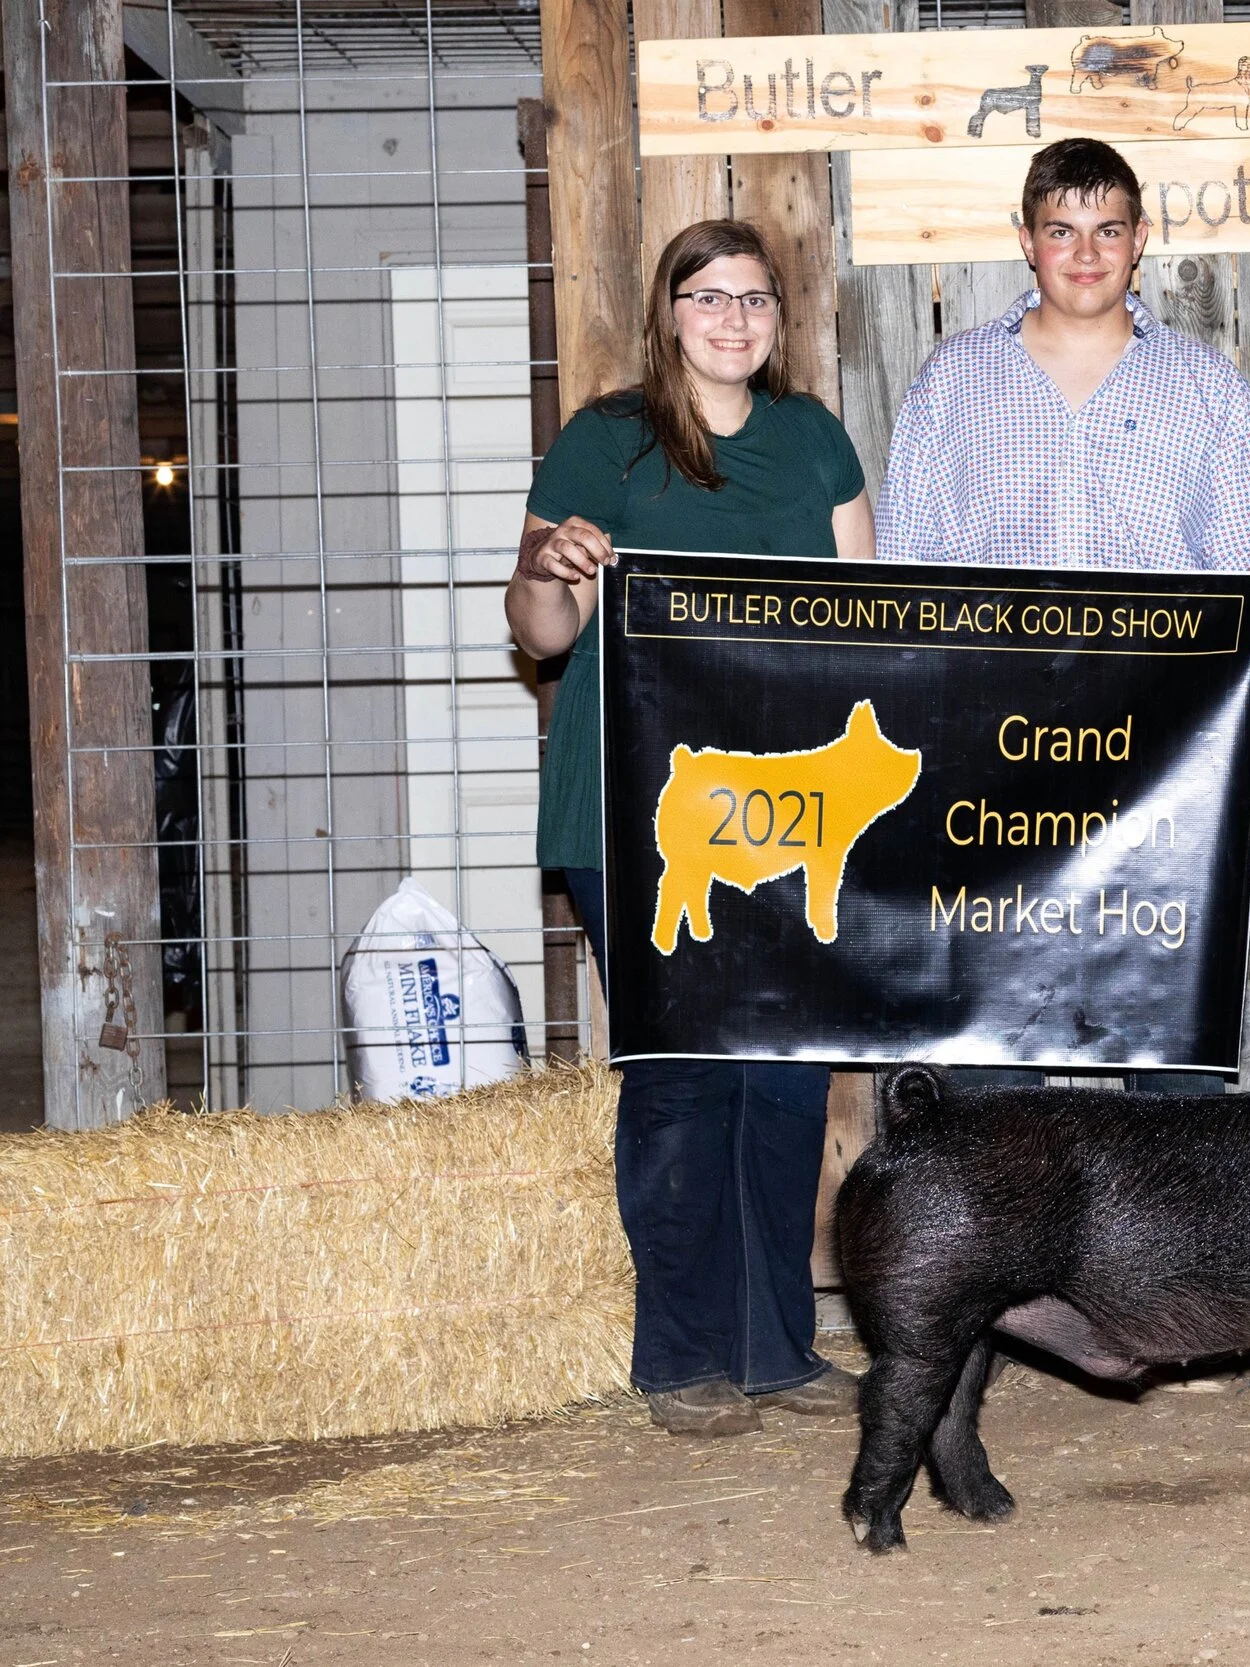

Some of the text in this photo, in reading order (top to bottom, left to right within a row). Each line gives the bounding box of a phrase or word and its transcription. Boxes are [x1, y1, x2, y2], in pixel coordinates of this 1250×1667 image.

[695, 56, 883, 122] Butler
[669, 591, 1202, 638] BUTLER COUNTY BLACK GOLD SHOW
[998, 714, 1133, 763] Grand
[707, 787, 825, 848] 2021
[945, 798, 1176, 858] Champion
[929, 884, 1187, 949] Market Hog
[398, 962, 418, 1004] MINI
